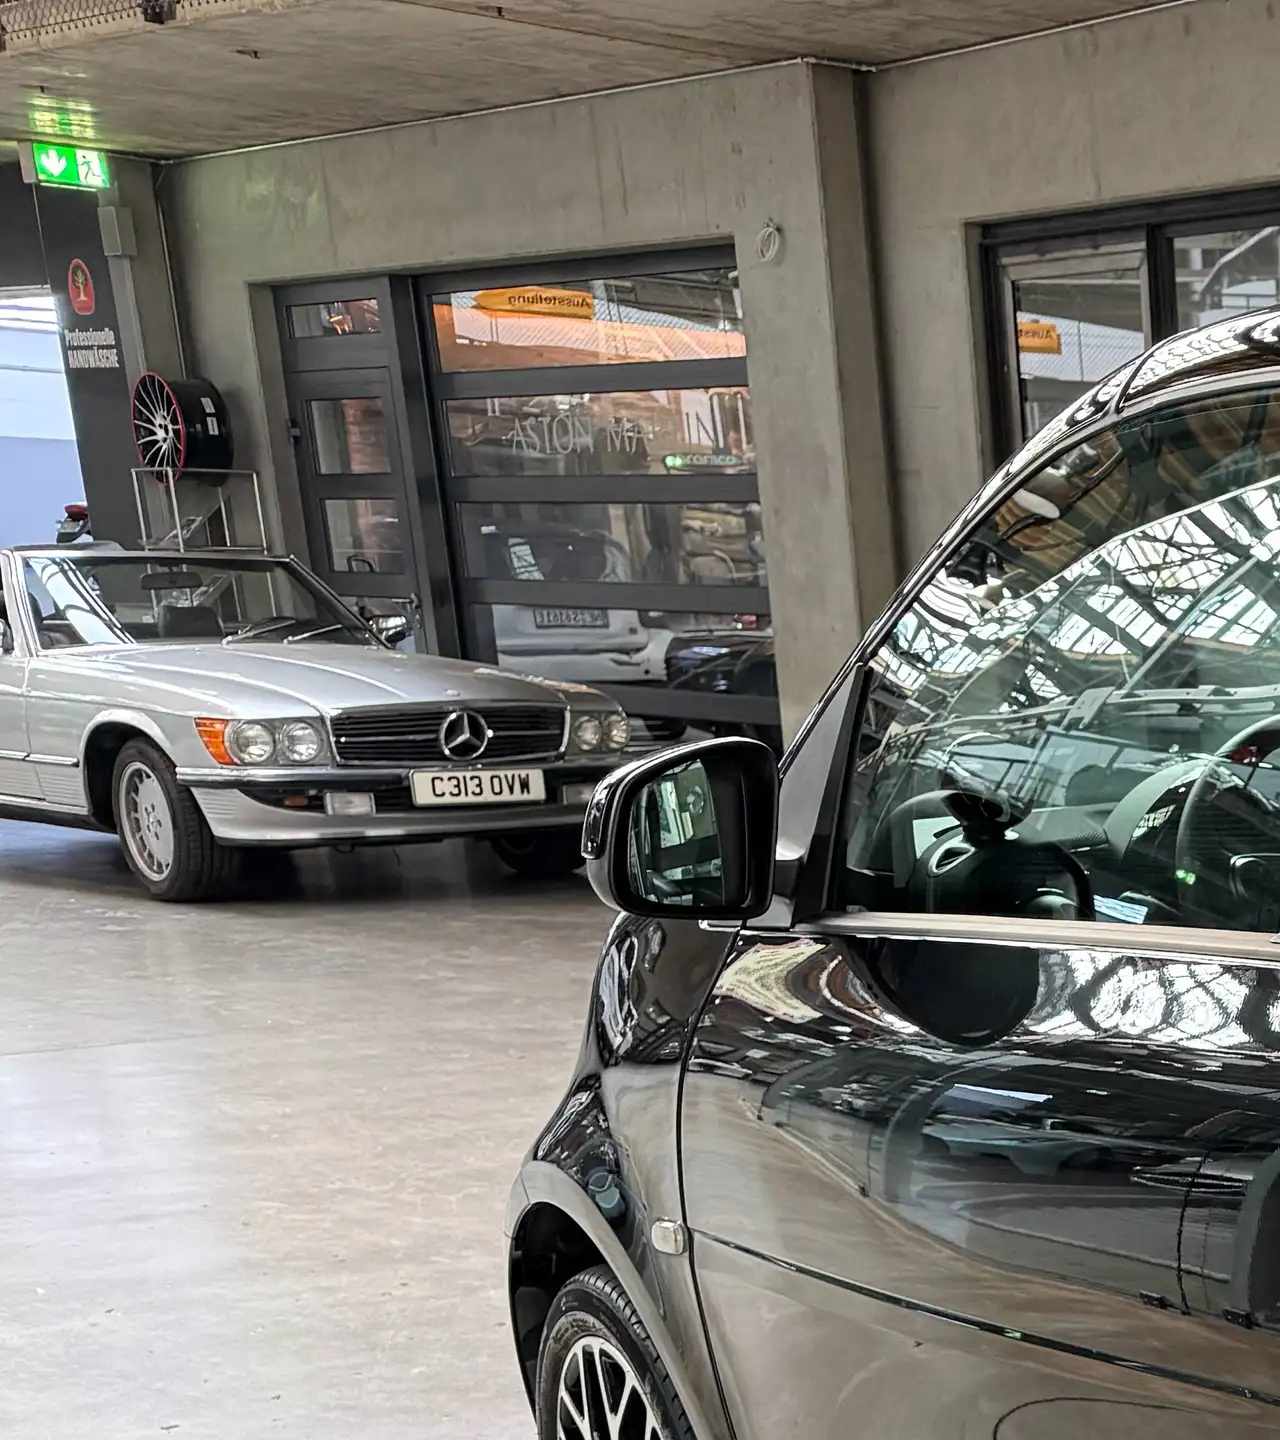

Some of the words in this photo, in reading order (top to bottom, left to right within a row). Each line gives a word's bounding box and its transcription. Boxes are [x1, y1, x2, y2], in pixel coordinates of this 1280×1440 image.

[512, 412, 594, 455] ASTON
[431, 774, 484, 798] C313
[490, 773, 531, 796] OVW
